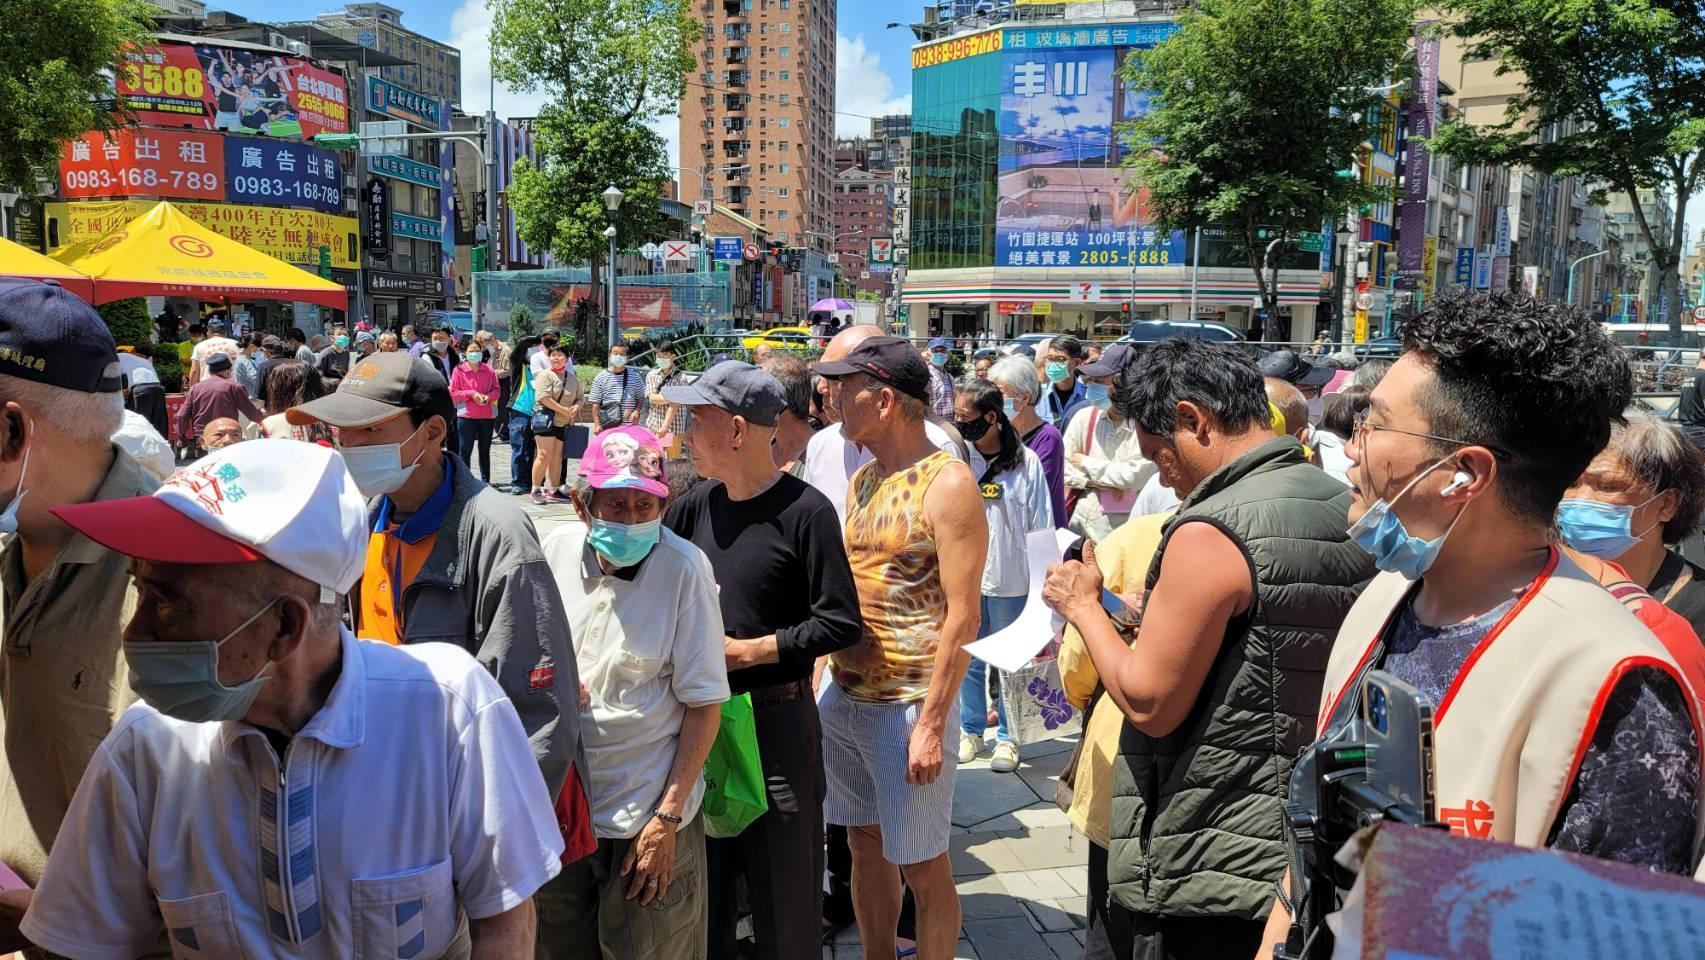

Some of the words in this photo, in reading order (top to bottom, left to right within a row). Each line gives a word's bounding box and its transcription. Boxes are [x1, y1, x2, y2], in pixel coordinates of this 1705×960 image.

[913, 31, 1000, 69] 0938-996-776
[1008, 32, 1026, 47] 租
[72, 137, 207, 164] 廣告出租
[241, 146, 335, 180] 廣告出租
[66, 168, 218, 191] 0983-168-789
[234, 176, 340, 205] 0983-168-789
[1008, 232, 1079, 247] 竹圍捷運站
[1008, 251, 1071, 265] 絕美實景
